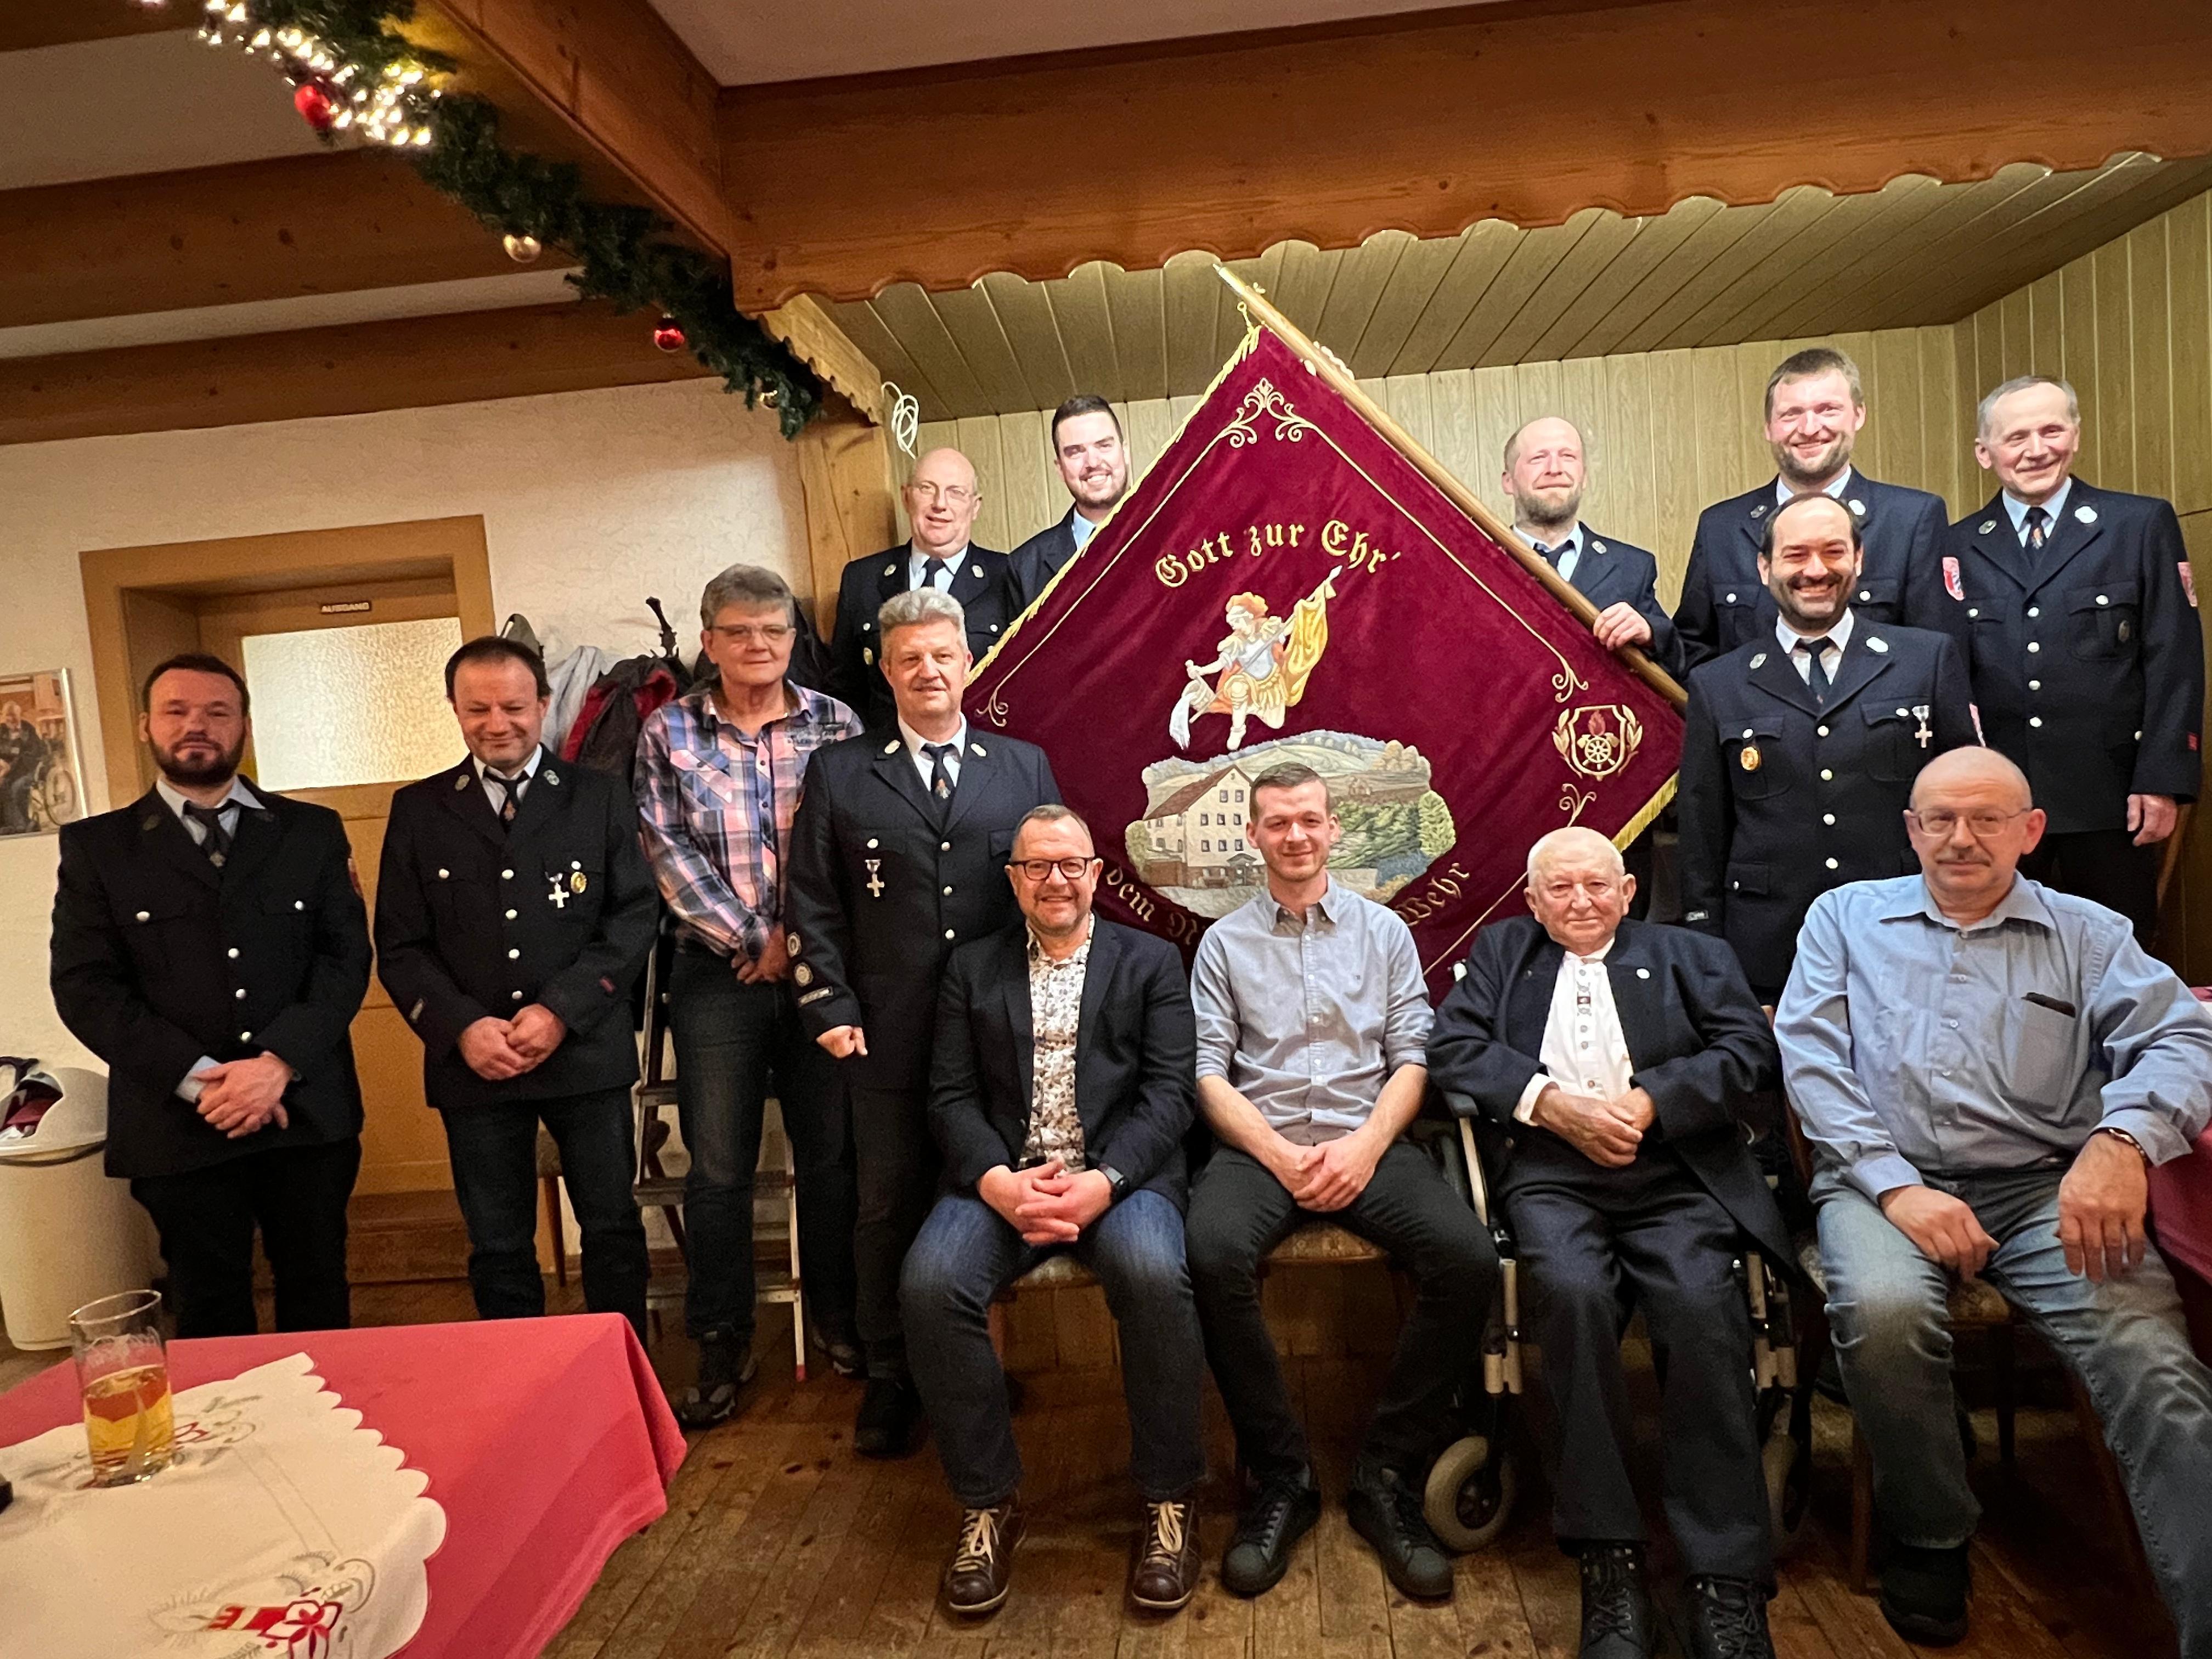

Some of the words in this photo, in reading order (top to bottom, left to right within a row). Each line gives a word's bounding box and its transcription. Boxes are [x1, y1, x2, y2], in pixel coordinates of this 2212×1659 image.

[1155, 531, 1234, 588] Gott
[1249, 523, 1305, 556] zur
[1106, 866, 1155, 922] dem
[1393, 862, 1471, 927] Wehr
